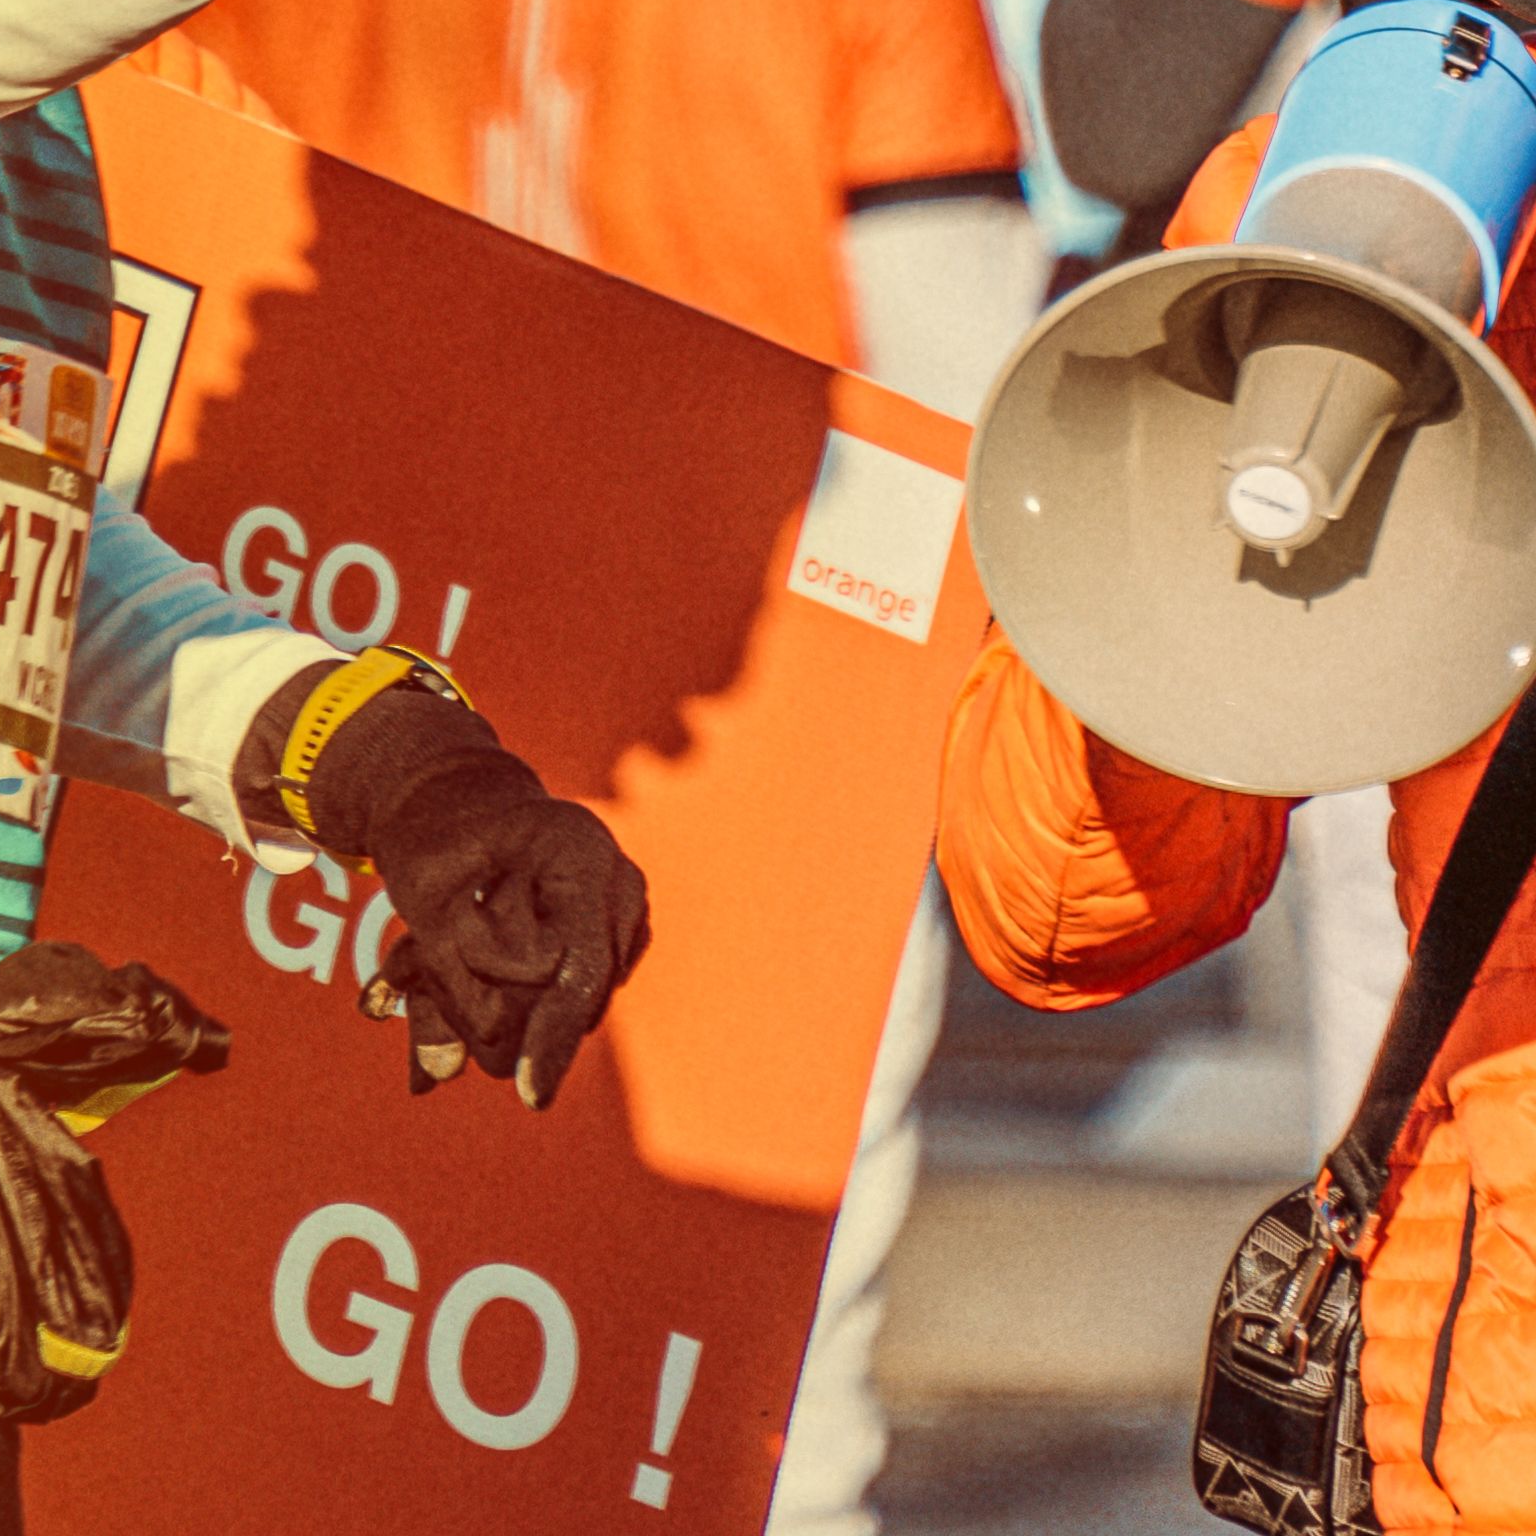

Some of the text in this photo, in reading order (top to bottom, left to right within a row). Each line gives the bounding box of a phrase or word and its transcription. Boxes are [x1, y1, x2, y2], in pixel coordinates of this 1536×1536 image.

[222, 505, 400, 653] GO
[803, 558, 918, 623] orange
[271, 1202, 703, 1510] GO !
